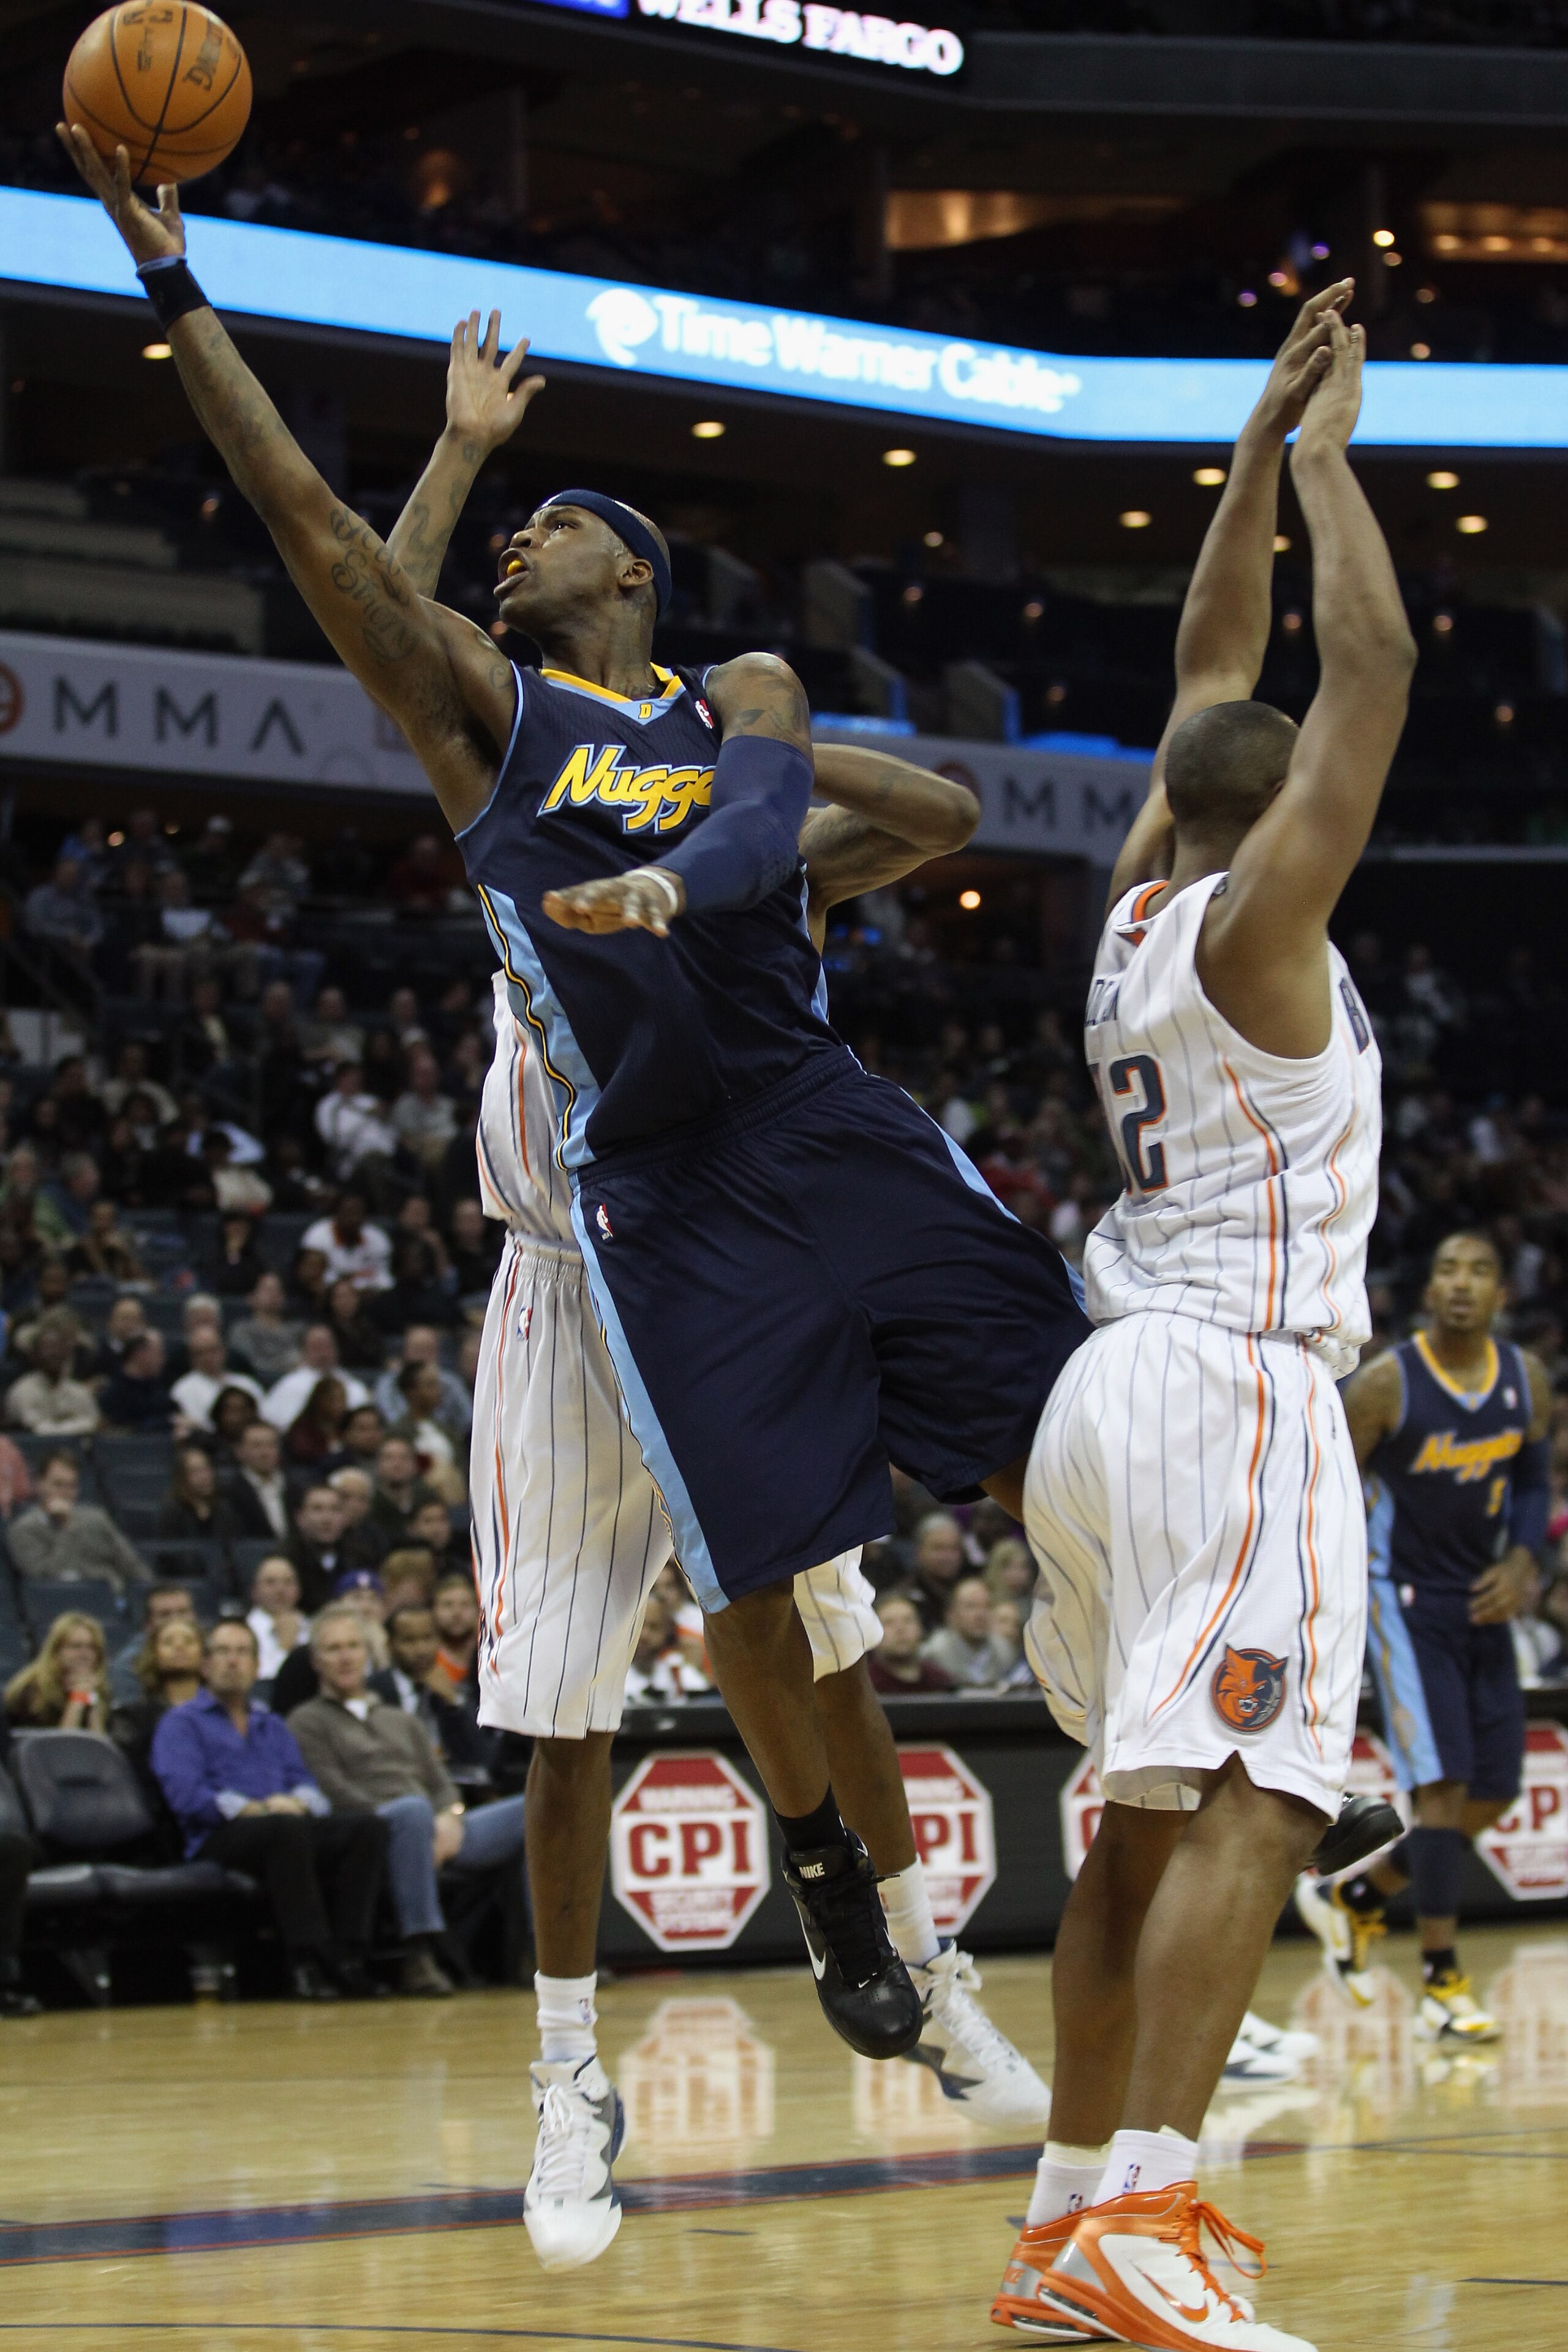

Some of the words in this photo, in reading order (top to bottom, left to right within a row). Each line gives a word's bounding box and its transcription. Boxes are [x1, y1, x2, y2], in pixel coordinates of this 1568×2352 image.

[804, 5, 963, 75] FARGO
[652, 295, 773, 366] Time
[772, 314, 938, 392] Warner
[638, 703, 652, 719] D
[628, 1822, 752, 1879] CPI
[799, 1862, 826, 1879] NIKE
